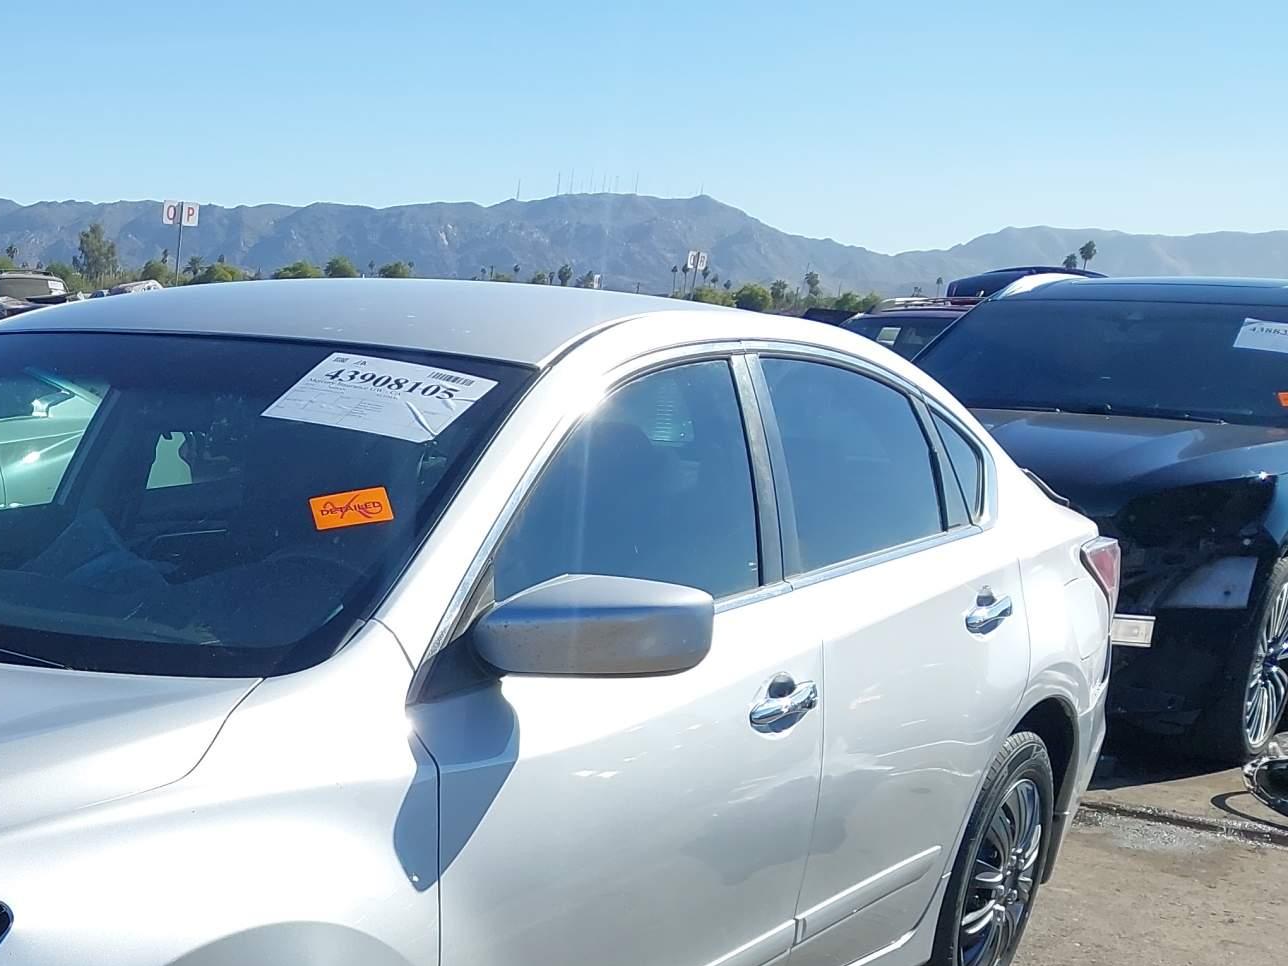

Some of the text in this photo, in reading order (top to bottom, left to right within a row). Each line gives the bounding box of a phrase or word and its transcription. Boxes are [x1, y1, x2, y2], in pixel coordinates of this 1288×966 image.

[187, 206, 195, 222] P
[325, 368, 460, 400] 43908105
[320, 501, 382, 517] DETAILED
